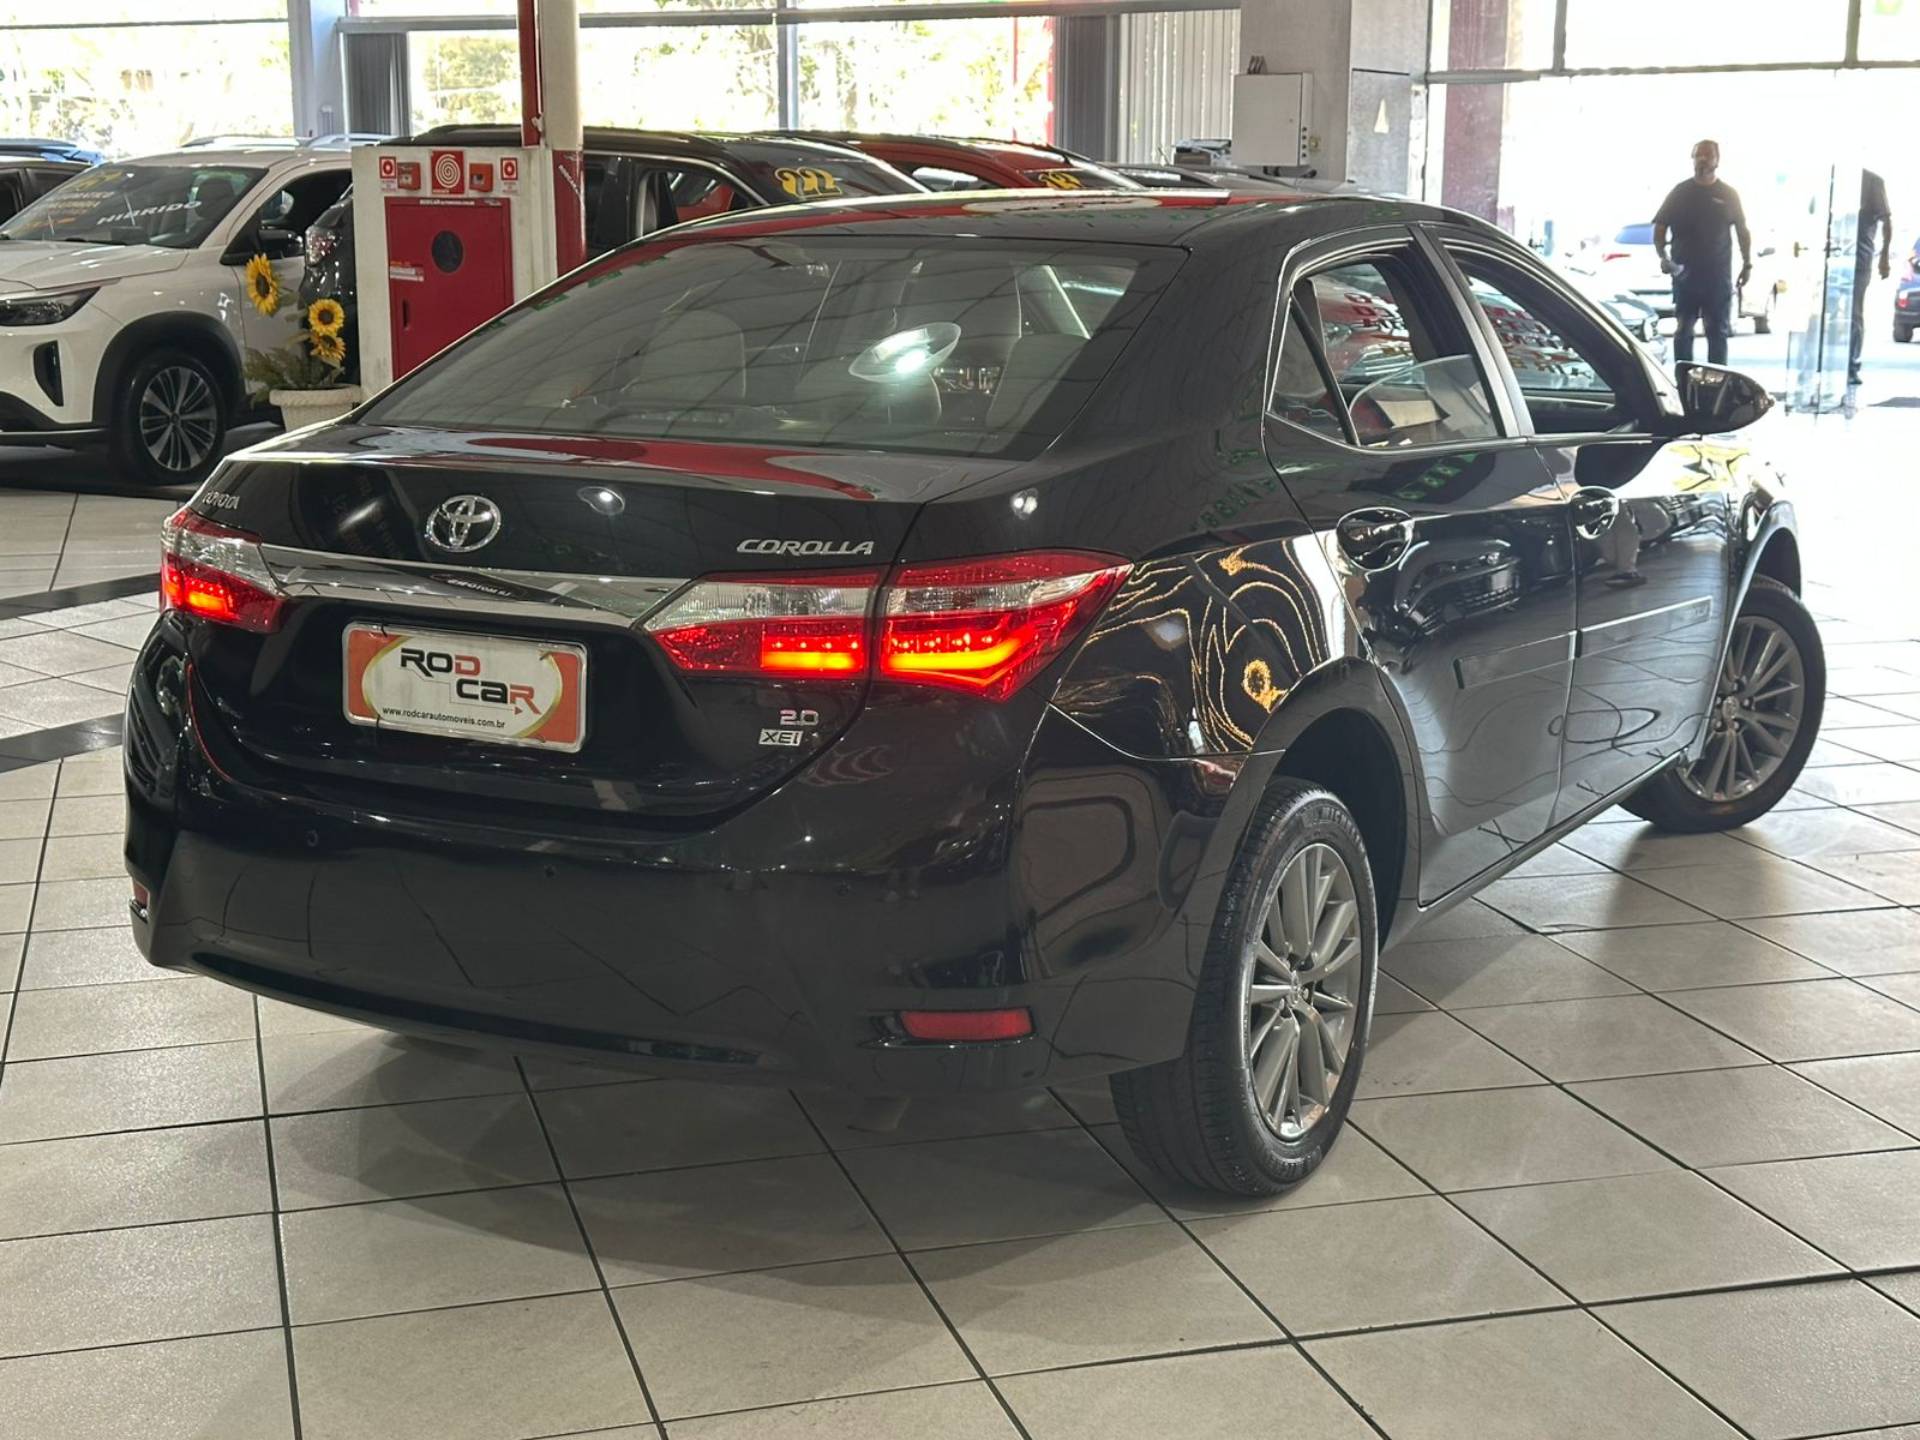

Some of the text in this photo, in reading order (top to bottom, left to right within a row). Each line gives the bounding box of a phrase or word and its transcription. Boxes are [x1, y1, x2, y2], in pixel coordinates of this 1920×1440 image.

[201, 491, 241, 510] TOYOTA
[736, 538, 875, 557] COROLLA
[400, 647, 481, 678] ROD
[382, 705, 506, 730] www.rodcarautomoveis.com.br
[779, 708, 819, 727] 2.0
